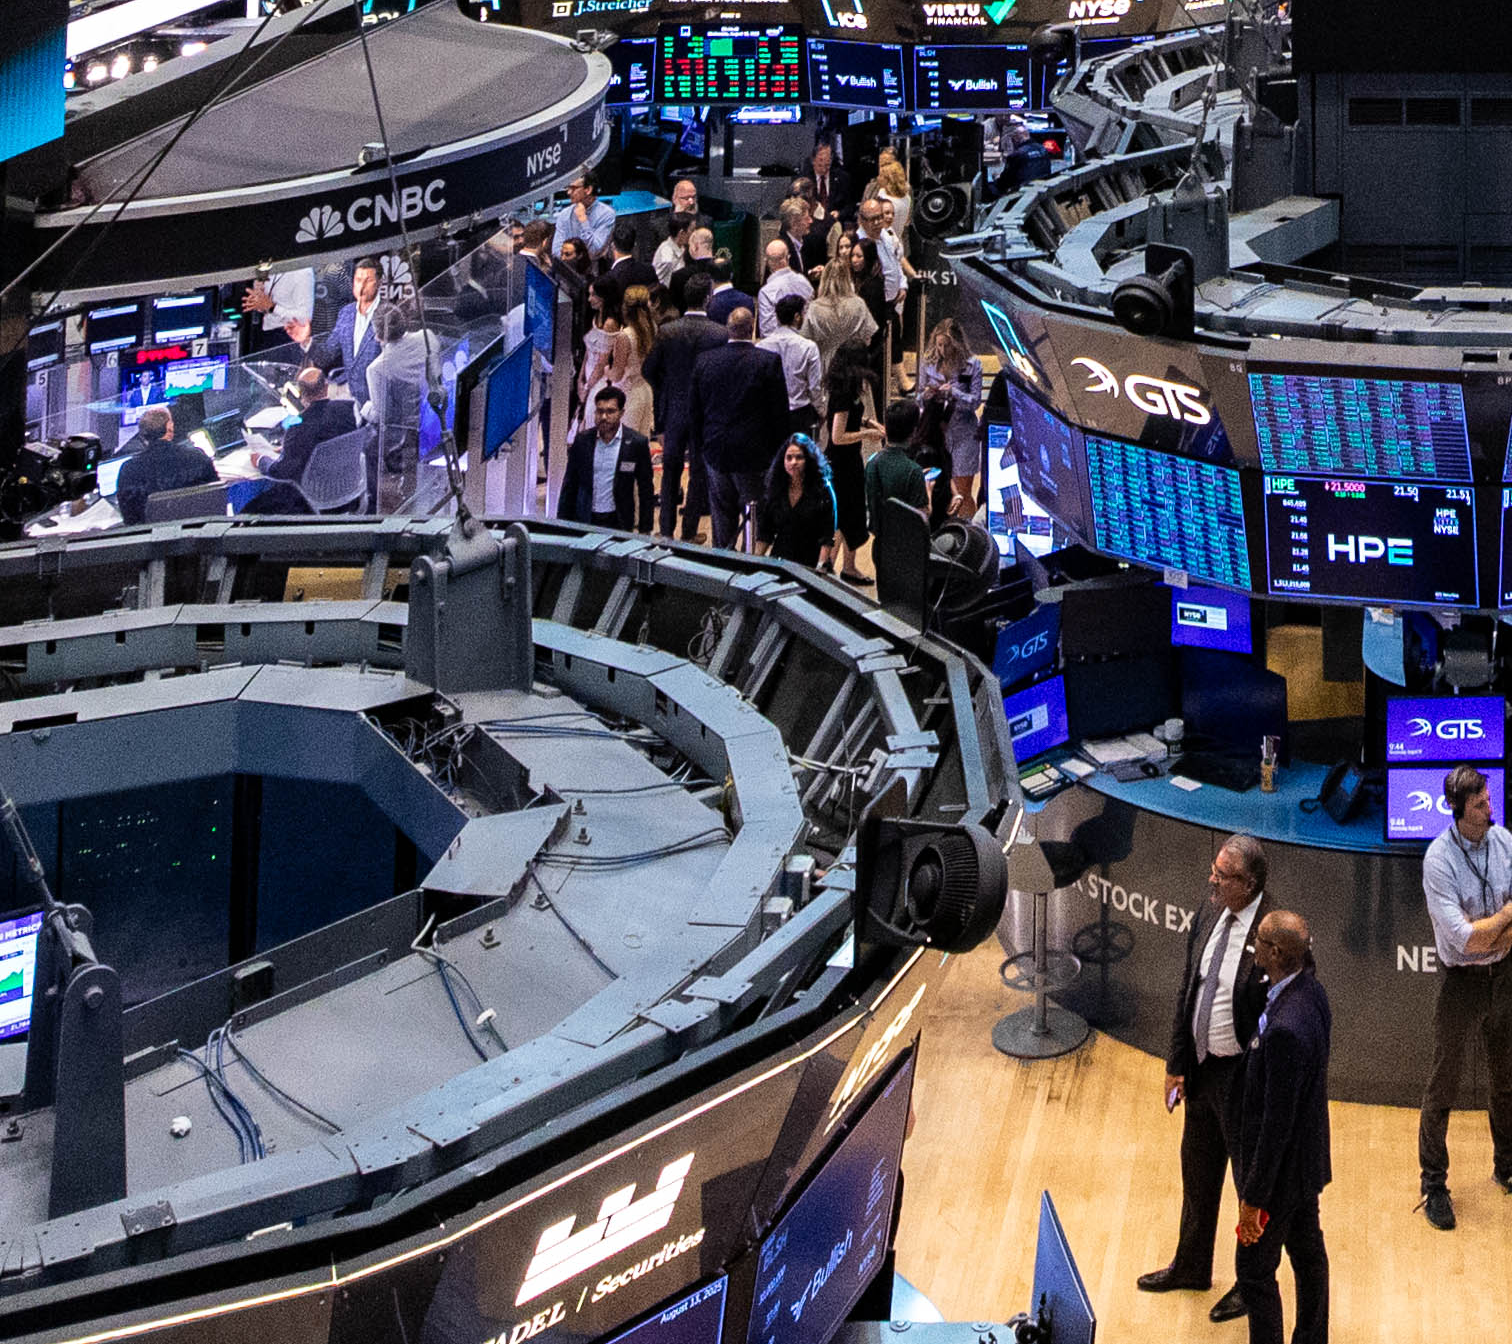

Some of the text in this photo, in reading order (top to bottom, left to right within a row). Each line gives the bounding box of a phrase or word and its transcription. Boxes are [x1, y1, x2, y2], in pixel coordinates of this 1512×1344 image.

[923, 3, 981, 17] VIRTU
[926, 16, 988, 26] FINANCIAL
[965, 79, 998, 91] Bullish
[346, 178, 447, 232] CNBC
[194, 342, 205, 357] 7
[36, 371, 47, 386] 5
[1123, 374, 1211, 426] GTS
[1271, 477, 1295, 491] HPE
[1435, 508, 1457, 519] HPE
[1433, 525, 1460, 536] NYSE
[1327, 533, 1414, 567] HPE
[1021, 630, 1049, 659] GTS
[1087, 873, 1160, 926] STOCK
[1397, 944, 1437, 973] NE
[591, 1228, 706, 1304] Securities
[660, 1302, 689, 1325] August
